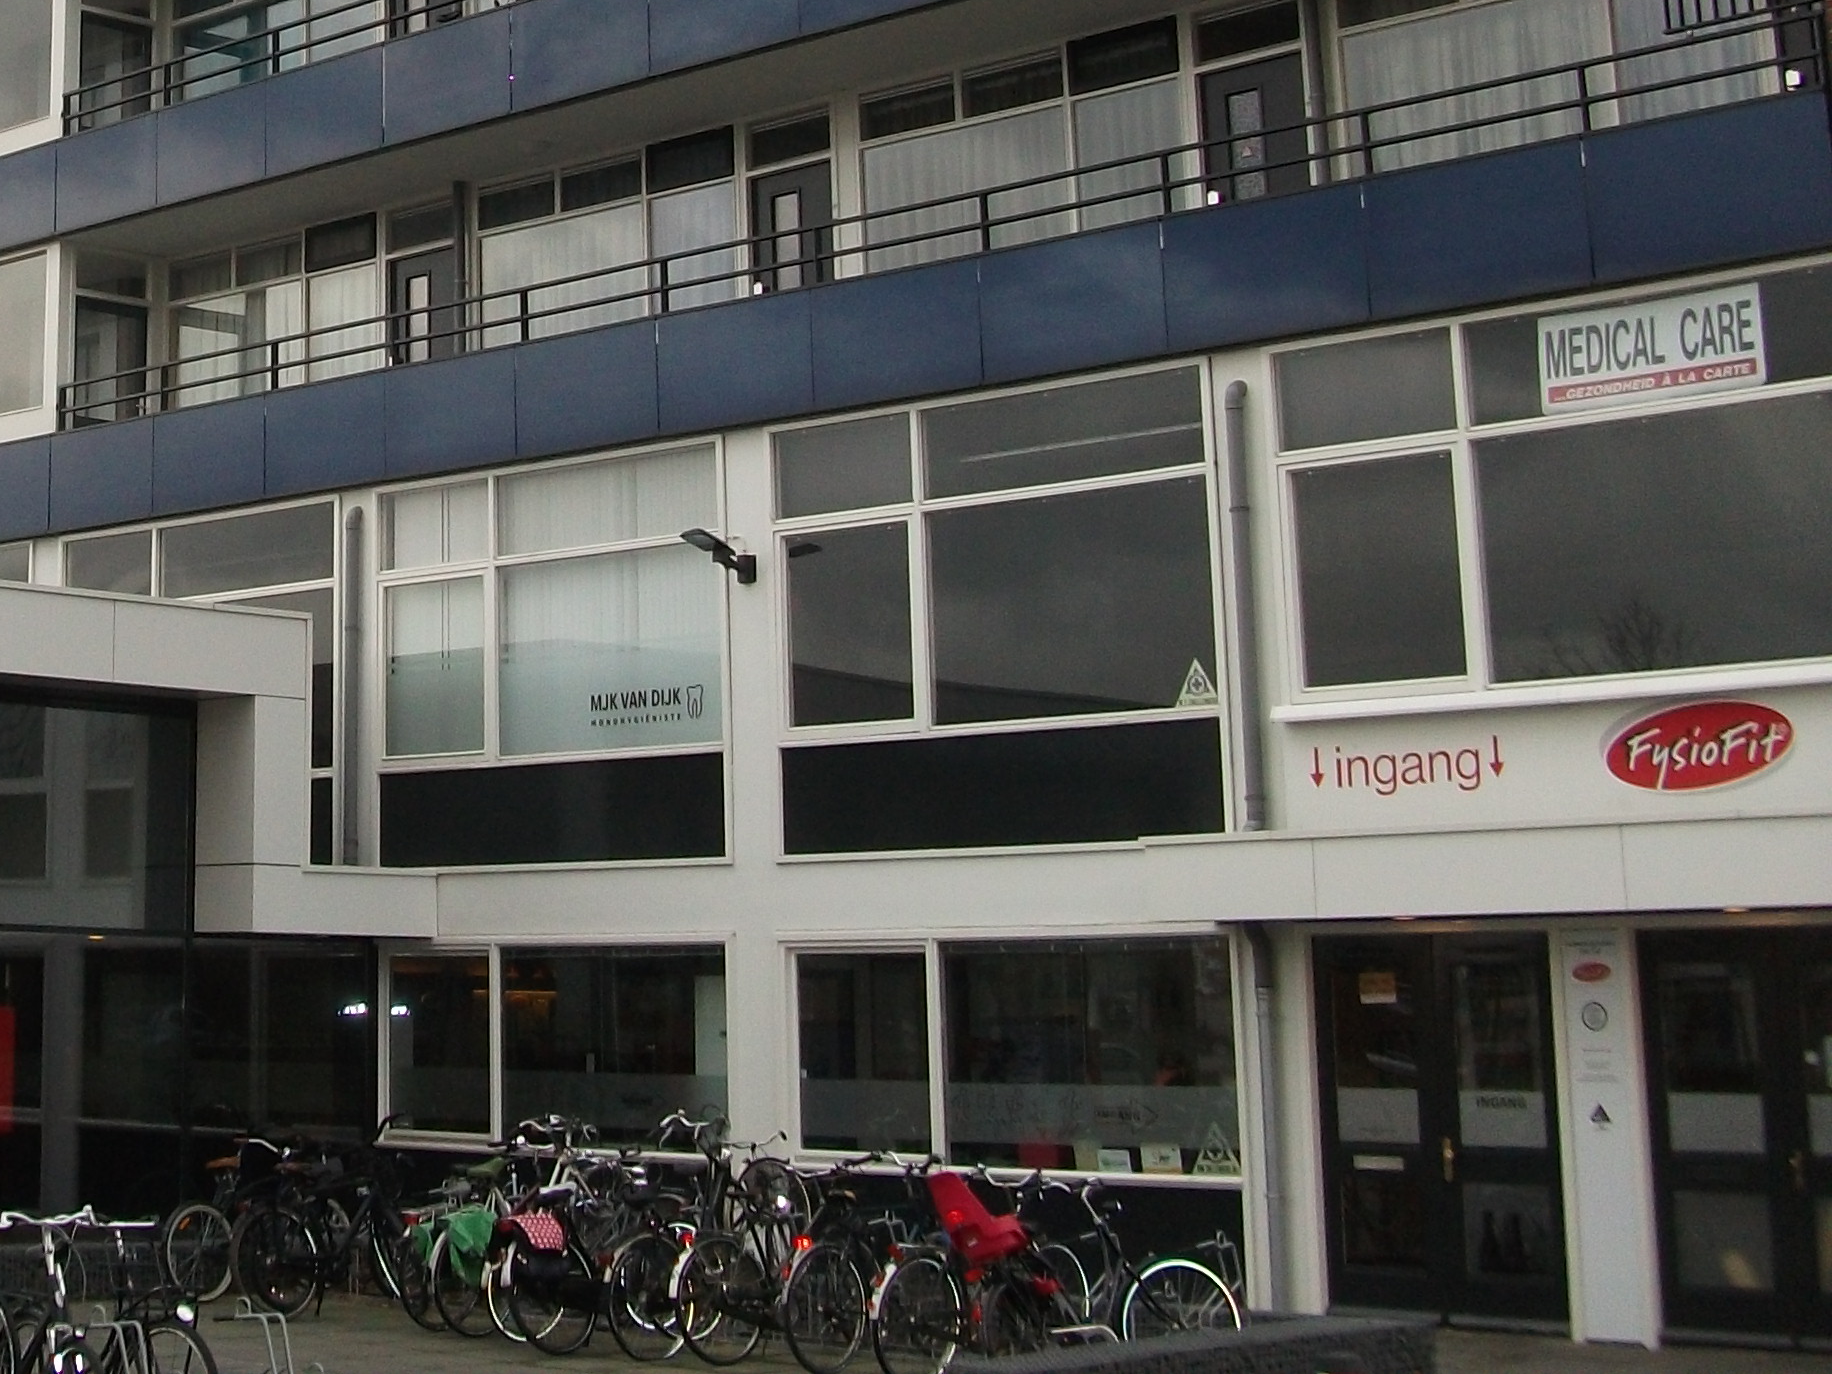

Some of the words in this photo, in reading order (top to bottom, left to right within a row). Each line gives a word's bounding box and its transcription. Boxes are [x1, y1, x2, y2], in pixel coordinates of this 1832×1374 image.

[1544, 315, 1666, 380] MEDICAL
[1679, 299, 1756, 362] CARE
[1677, 371, 1698, 385] LA
[1702, 362, 1751, 381] CARTE
[590, 692, 619, 712] MJK
[620, 690, 648, 710] VAN
[650, 687, 682, 708] DIJK
[1334, 745, 1482, 797] ingang
[1627, 720, 1786, 791] FysioFit
